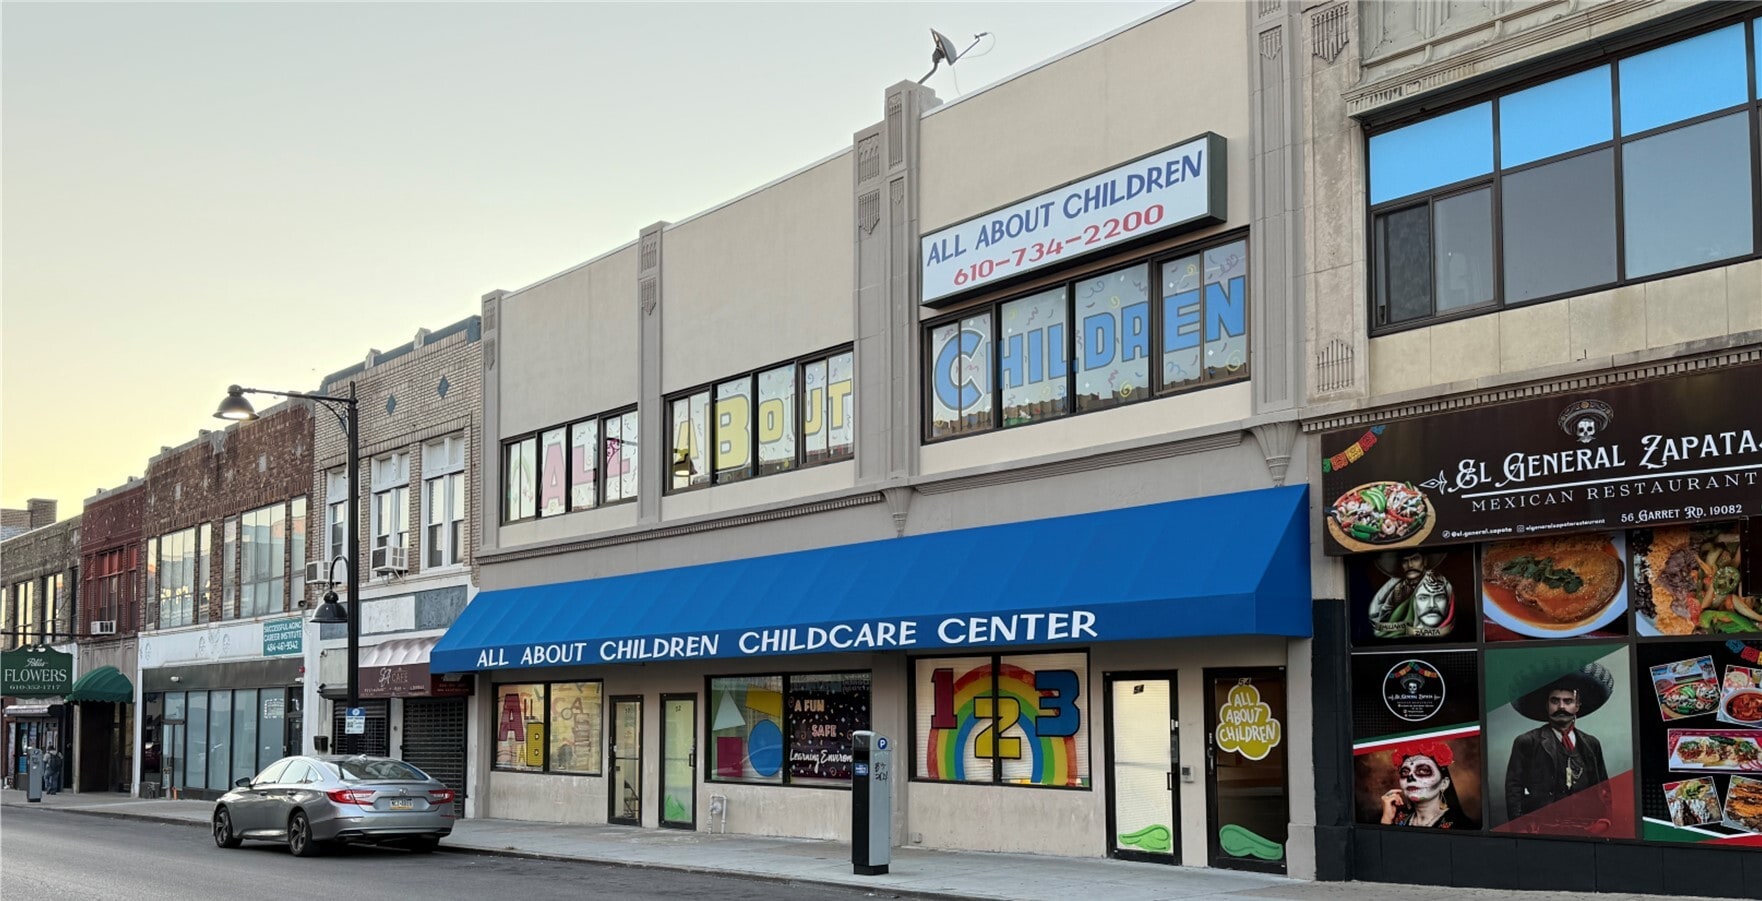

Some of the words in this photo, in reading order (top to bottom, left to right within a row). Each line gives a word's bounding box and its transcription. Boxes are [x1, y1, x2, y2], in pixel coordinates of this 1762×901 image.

[926, 234, 967, 267] ALL
[975, 201, 1055, 250] ABOUT
[1063, 150, 1202, 218] CHILDREN
[953, 204, 1164, 286] 610-734-2200
[1448, 459, 1492, 493] EL
[1495, 444, 1626, 488] GENERAL
[1639, 429, 1759, 469] ZAPATA
[1472, 490, 1574, 512] MEXICAN
[1586, 472, 1757, 500] RESTAURANT
[1621, 513, 1635, 523] 56
[1635, 508, 1680, 524] GARRET
[1709, 504, 1743, 516] 19082
[477, 648, 509, 667] ALL
[520, 642, 587, 665] ABOUT
[600, 634, 719, 661] CHILDREN
[739, 620, 917, 654] CHILDCARE
[937, 610, 1098, 644] CENTER
[4, 669, 67, 682] FLOWERS
[794, 699, 802, 712] A
[804, 699, 825, 712] FUN
[1234, 691, 1253, 708] ALL
[1225, 707, 1262, 725] ABOUT
[811, 724, 837, 738] SAFE
[1219, 721, 1276, 743] CHILDREN
[789, 749, 820, 774] Learning
